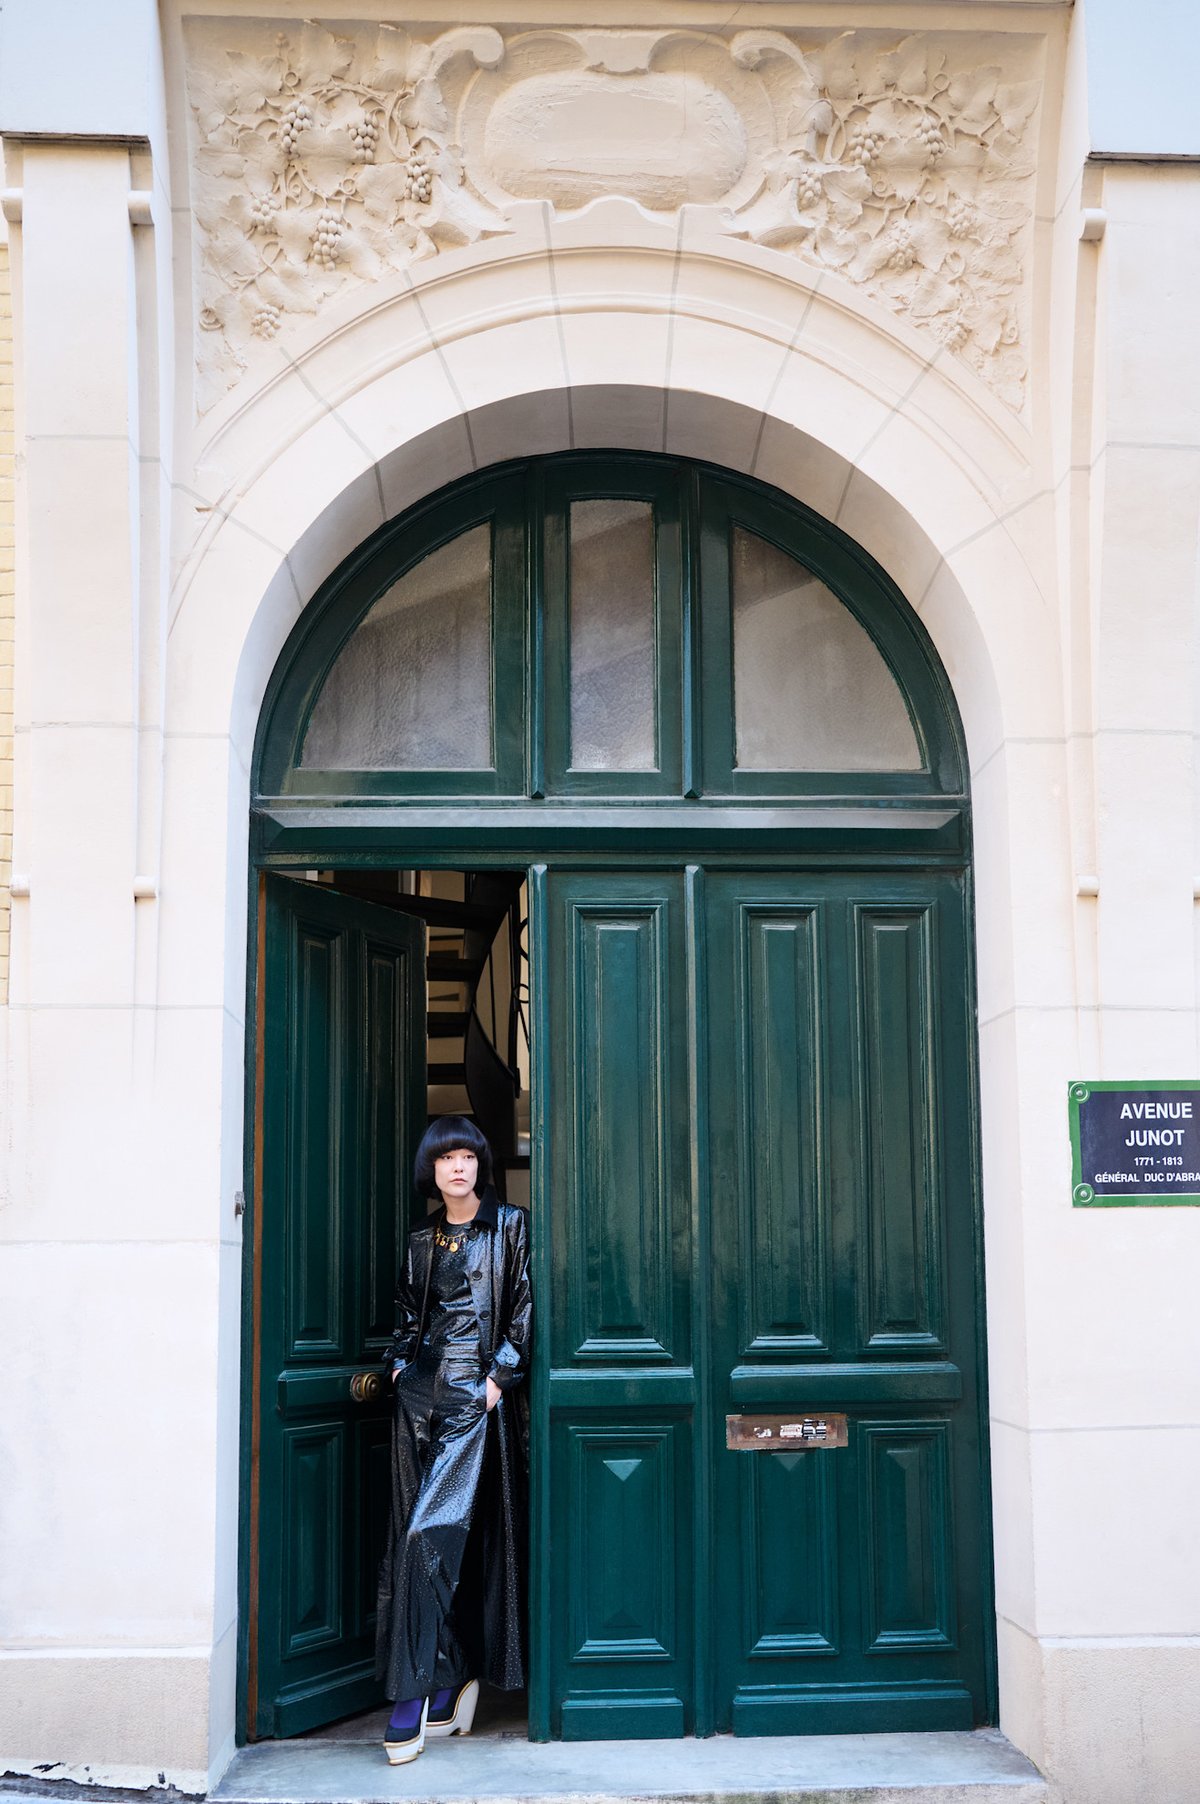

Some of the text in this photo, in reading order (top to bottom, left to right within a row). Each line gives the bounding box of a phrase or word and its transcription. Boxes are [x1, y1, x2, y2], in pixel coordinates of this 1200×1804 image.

[1119, 1101, 1194, 1120] AVENUE
[1124, 1129, 1186, 1147] JUNOT
[1133, 1156, 1154, 1166] 1771
[1162, 1156, 1183, 1166] 1813
[1094, 1171, 1140, 1183] GÉNÉRAL
[1143, 1172, 1165, 1183] DUC
